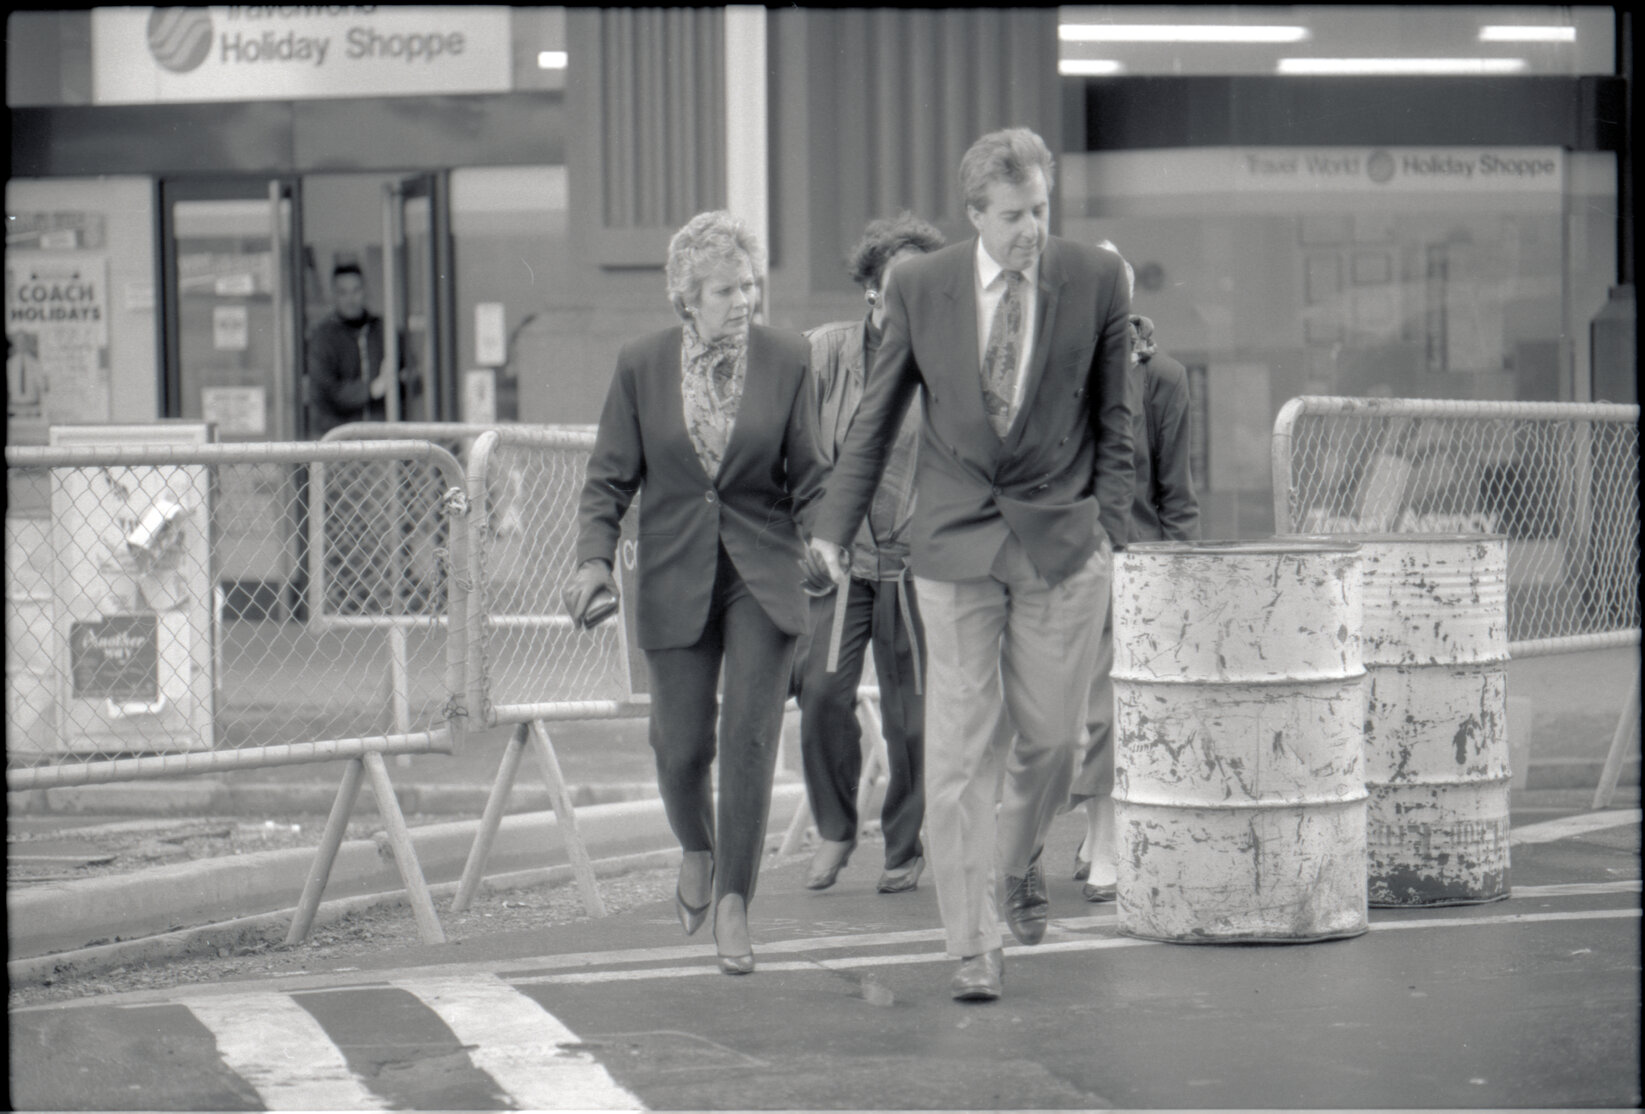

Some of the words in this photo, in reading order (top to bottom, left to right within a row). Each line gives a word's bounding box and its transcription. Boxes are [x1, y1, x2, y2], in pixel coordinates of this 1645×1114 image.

[220, 31, 329, 66] Holiday
[347, 27, 466, 63] Shoppe
[1247, 154, 1297, 174] Travel
[1302, 154, 1359, 174] World
[1403, 153, 1473, 178] Holiday
[1480, 153, 1555, 177] Shoppe
[18, 285, 94, 302] COACH
[11, 308, 101, 321] HOLIDAYS
